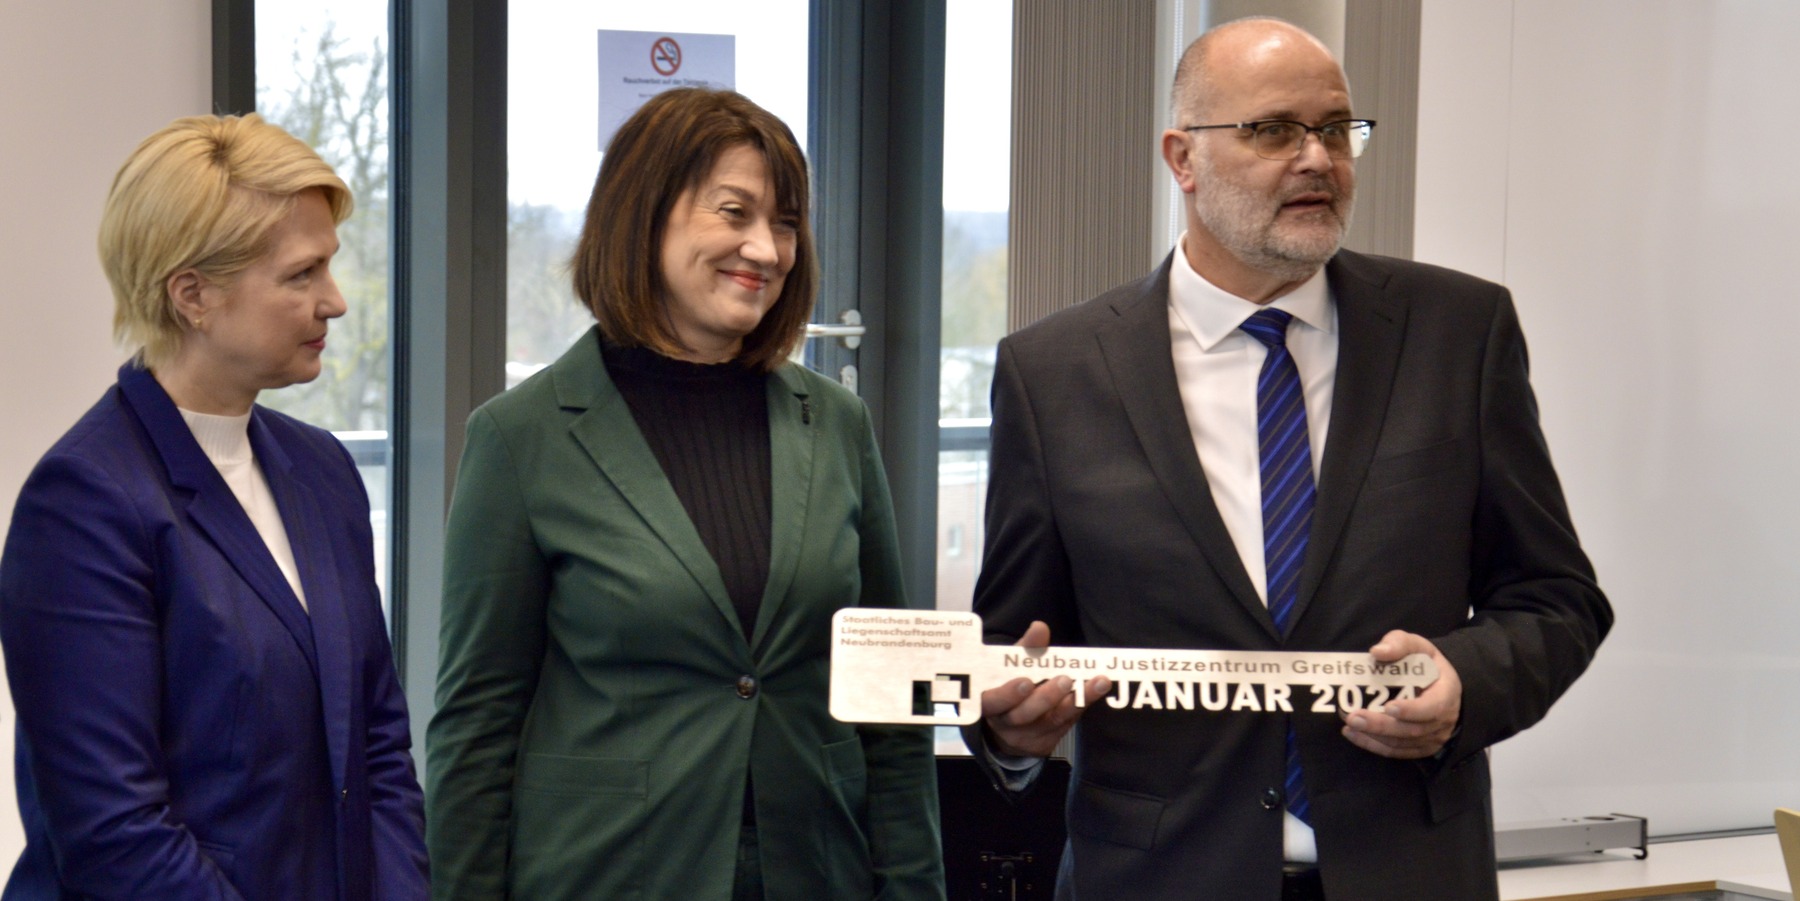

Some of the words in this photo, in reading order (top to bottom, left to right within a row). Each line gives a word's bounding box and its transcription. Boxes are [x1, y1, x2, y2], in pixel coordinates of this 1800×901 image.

[842, 615, 910, 625] Staatliches
[914, 617, 945, 626] Bau-
[948, 618, 973, 626] und
[841, 627, 952, 637] Liegenschaftsamt
[840, 638, 952, 650] Neubrandenburg
[1004, 653, 1096, 670] Neubau
[1106, 656, 1281, 674] Justizzentrum
[1292, 659, 1425, 676] Greifswald
[1105, 679, 1294, 712] JANUAR
